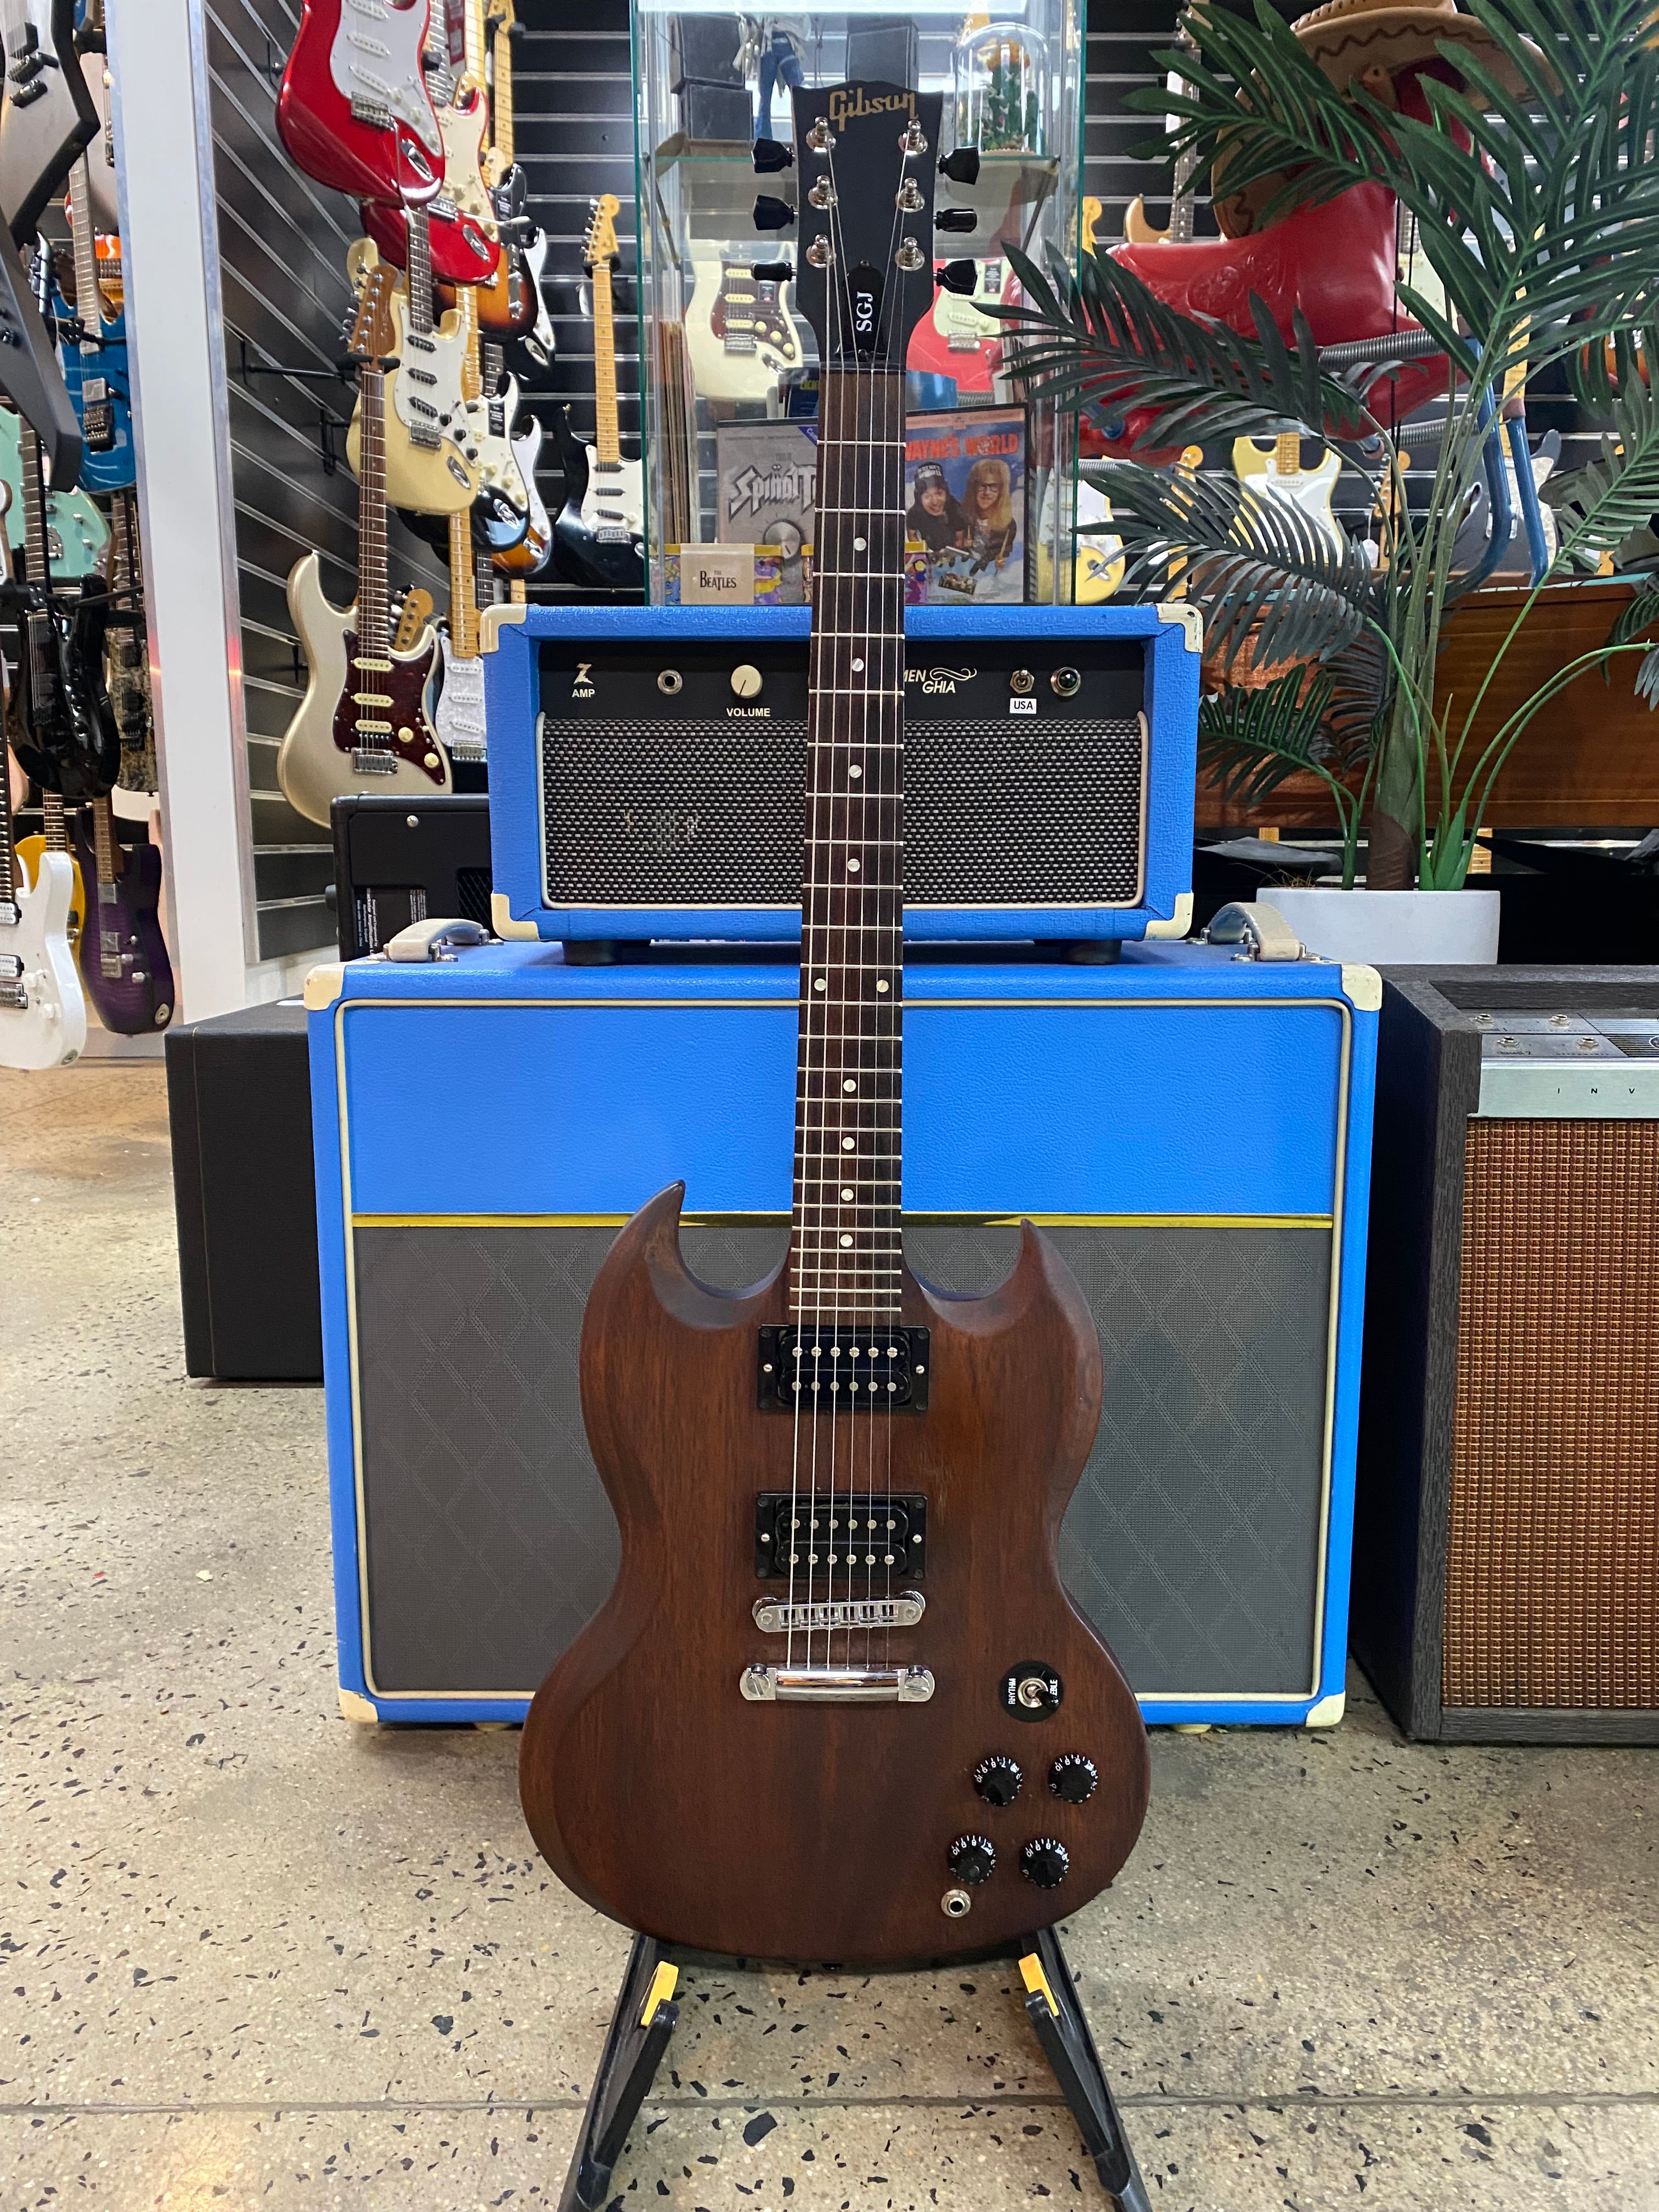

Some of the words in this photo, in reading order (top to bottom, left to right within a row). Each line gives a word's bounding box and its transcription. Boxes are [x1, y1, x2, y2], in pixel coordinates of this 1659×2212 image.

[830, 88, 918, 132] Gibson
[856, 291, 873, 332] SGJ
[964, 433, 1019, 456] WORLD
[700, 571, 736, 590] BEATLES
[572, 689, 595, 697] AMP
[922, 680, 956, 693] GHIA
[726, 708, 771, 716] VOLUME
[1014, 701, 1033, 709] USA
[1049, 1679, 1058, 1696] EBLE
